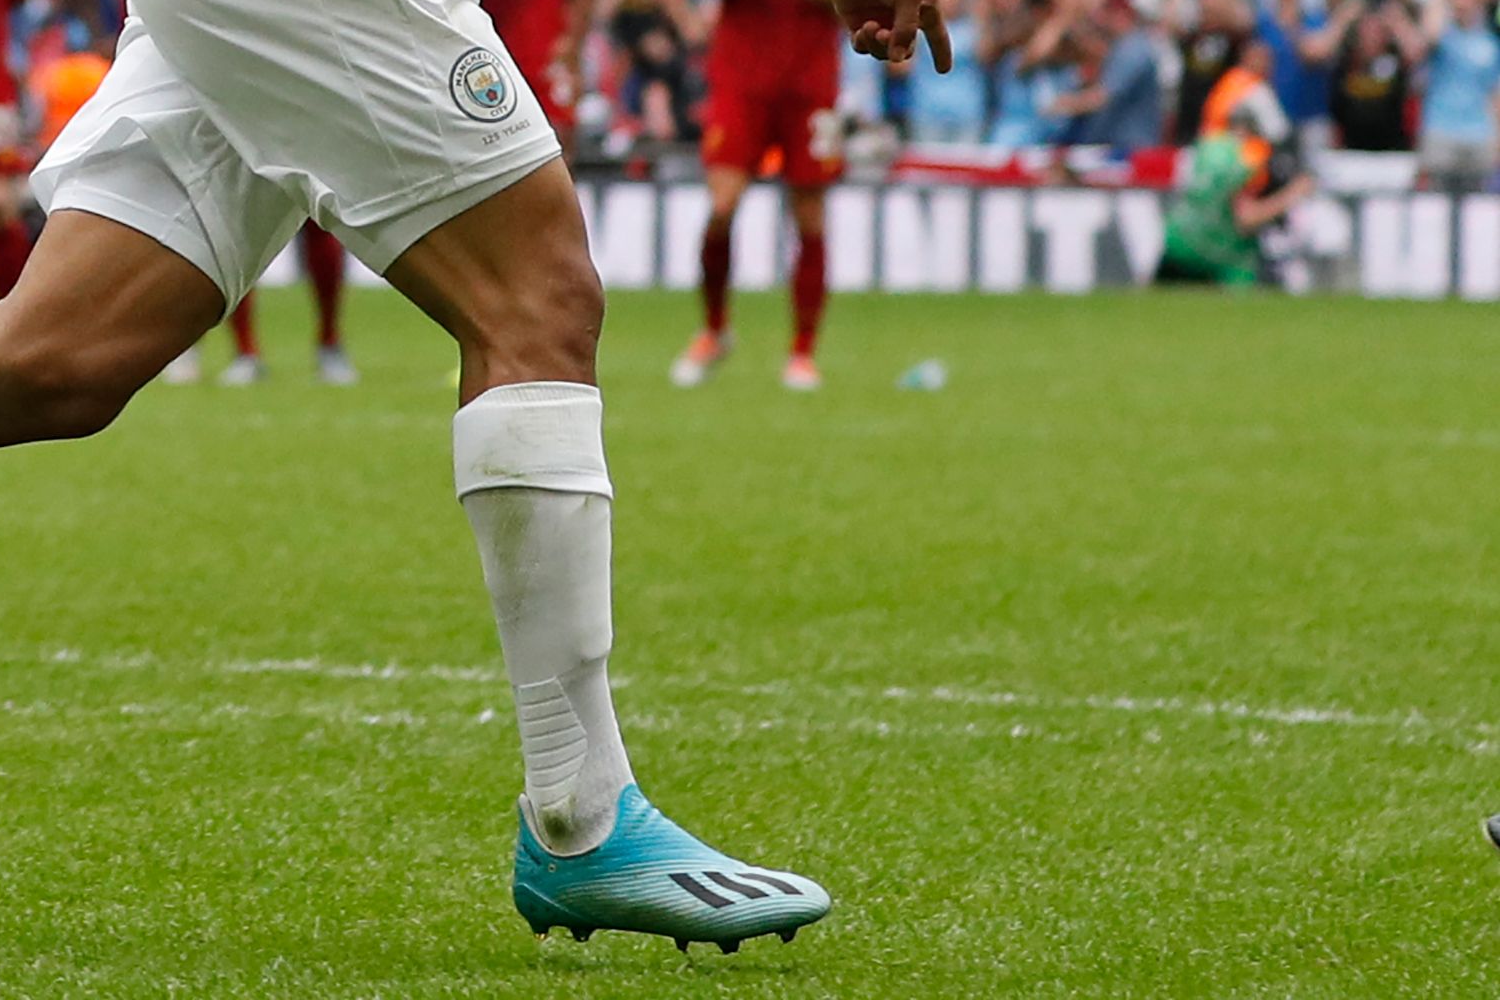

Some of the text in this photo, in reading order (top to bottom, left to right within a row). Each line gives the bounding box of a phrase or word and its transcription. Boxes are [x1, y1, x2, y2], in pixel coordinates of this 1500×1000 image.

[490, 104, 509, 117] CITY
[481, 119, 531, 145] 125 YEARS
